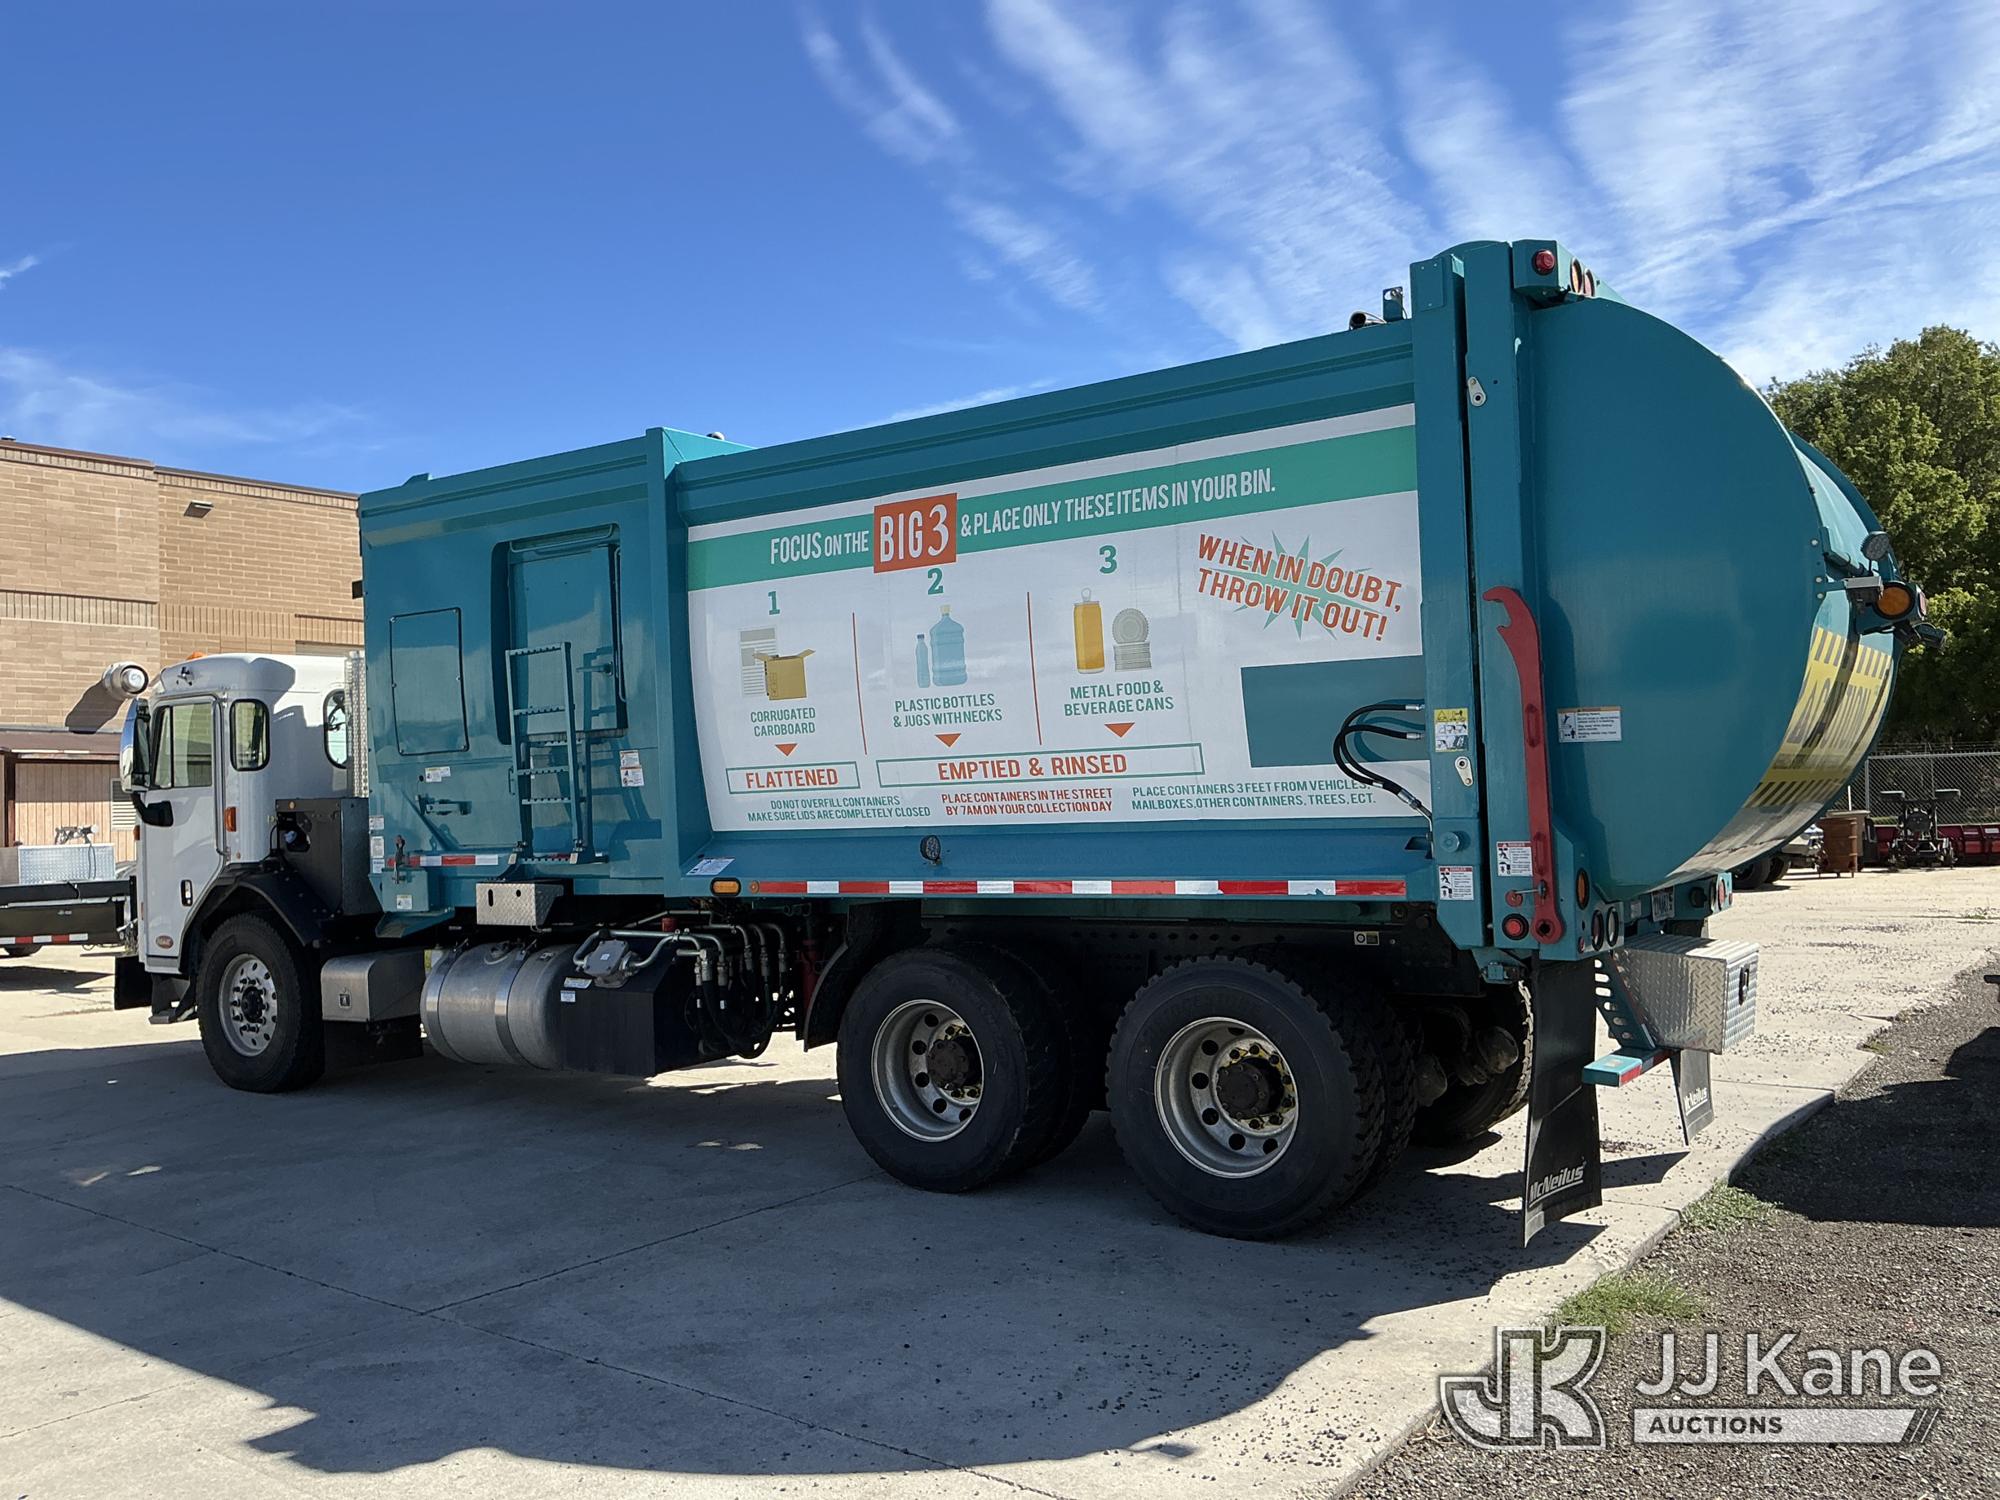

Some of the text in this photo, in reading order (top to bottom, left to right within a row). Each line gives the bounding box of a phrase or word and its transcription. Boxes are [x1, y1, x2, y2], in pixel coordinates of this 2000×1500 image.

[770, 467, 1276, 565] FOCUS ON THE BIG 3 & PLACE ONLY THESE ITEMS IN YOUR BIN.
[1098, 545, 1118, 575] 3
[927, 567, 944, 596] 2
[1198, 533, 1402, 613] WHEN IN DOUBT,
[767, 590, 781, 616] 1
[1198, 567, 1388, 642] THROW IT OUT!
[1069, 679, 1164, 700] METAL FOOD &
[894, 693, 996, 713] PLASTIC BOTTLES
[1063, 696, 1175, 717] BEVERAGE CANS
[750, 707, 817, 723] CORRUGATED
[892, 708, 1003, 728] & JUGS WITH NECKS
[753, 722, 816, 737] CARDBOARD
[937, 753, 1128, 781] EMPTIED & RINSED
[745, 768, 839, 789] FLATTENED
[1132, 786, 1167, 797] PLACE
[1167, 783, 1236, 796] CONTAINERS
[1237, 783, 1245, 794] 3
[1245, 781, 1272, 793] FEET
[1273, 780, 1308, 792] FROM
[770, 795, 901, 810] DO NOT OVERFILL CONTAINERS
[941, 788, 1113, 804] PLACE CONTAINERS IN THE STREET
[1196, 797, 1232, 809] OTHER
[1350, 792, 1377, 804] ECT.
[747, 806, 931, 822] MAKE SURE LIDS ARE COMPLETELY CLOSED
[945, 801, 1113, 816] BY 7AM ON YOUR COLLECTION DAY
[1529, 1165, 1584, 1203] McNeilus
